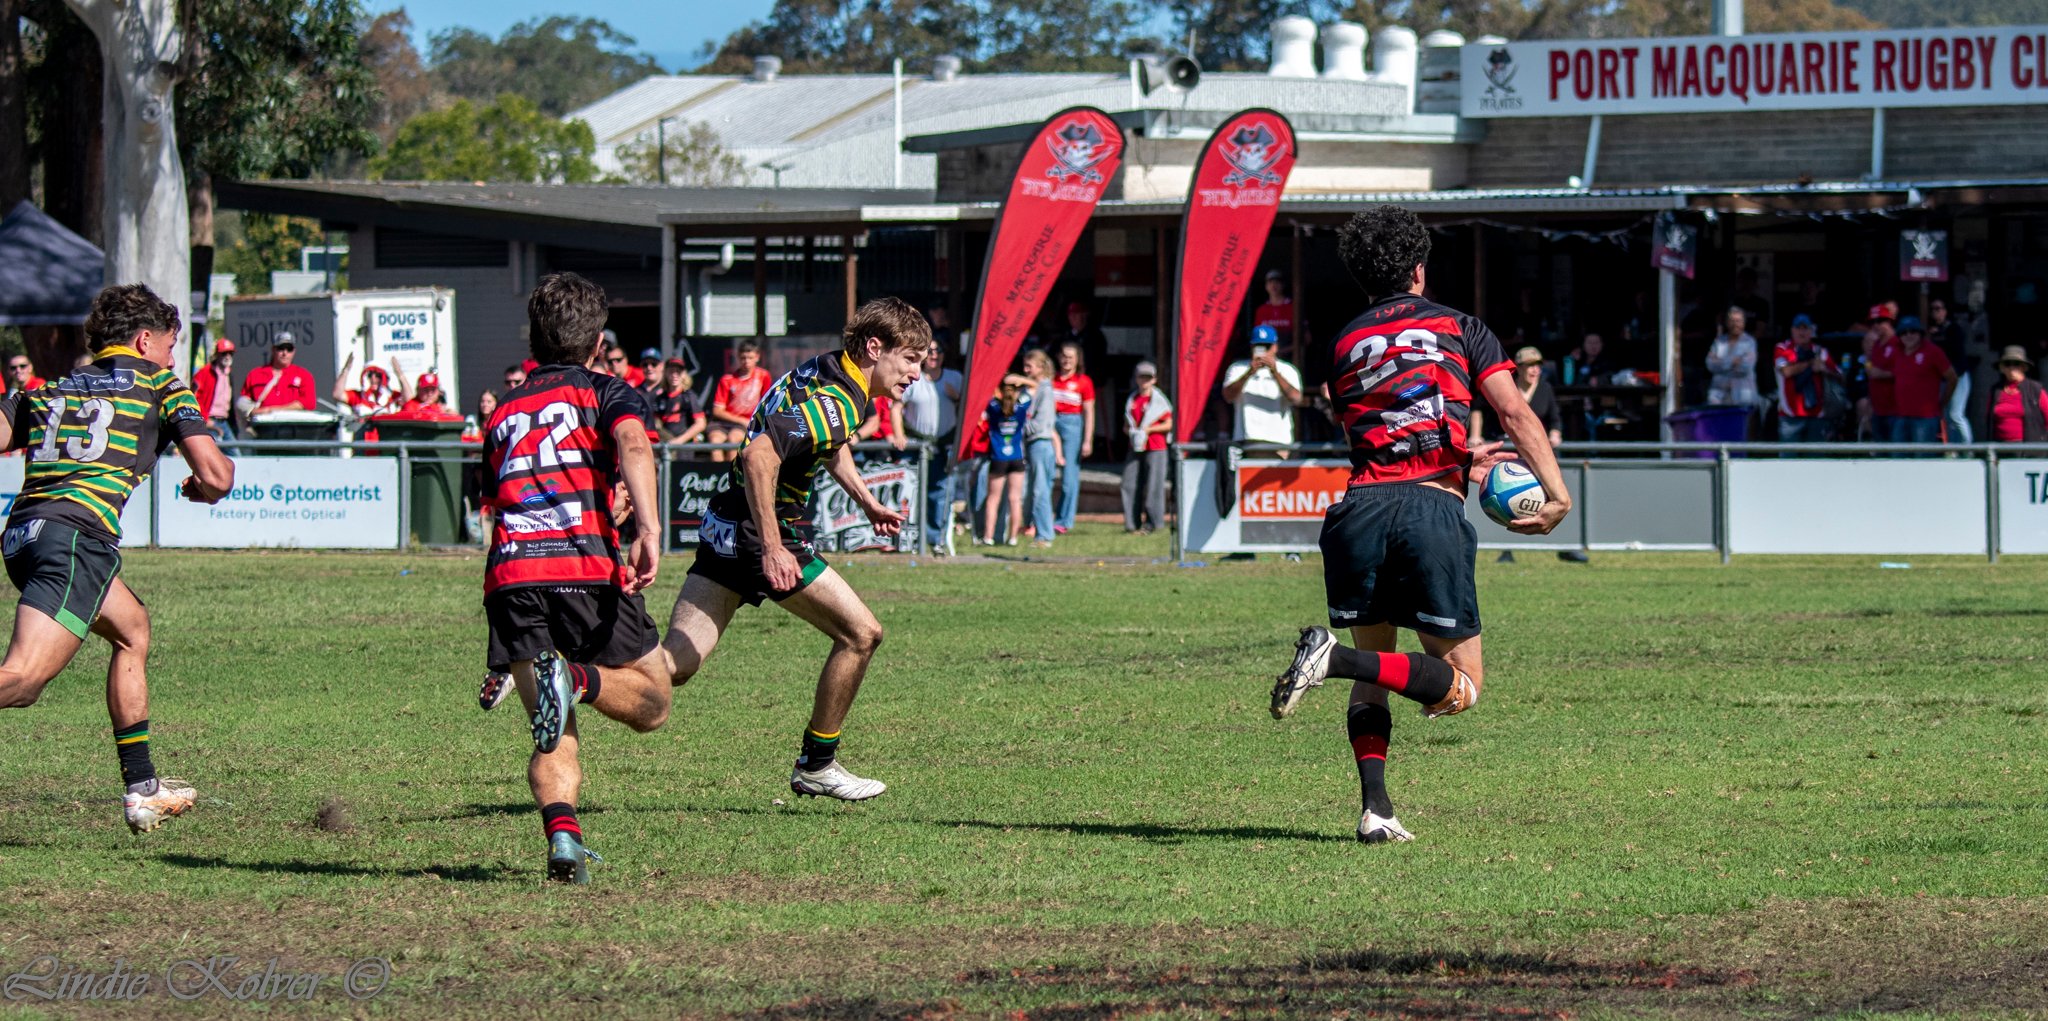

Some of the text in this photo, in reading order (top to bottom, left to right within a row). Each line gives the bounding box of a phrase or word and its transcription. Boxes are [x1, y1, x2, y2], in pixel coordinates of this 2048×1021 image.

[1548, 47, 1640, 101] PORT
[1652, 40, 1861, 105] MACQUARIE
[1873, 34, 1998, 92] RUGBY
[1020, 177, 1098, 202] PIRATES
[1199, 189, 1277, 208] PIRATES
[983, 224, 1057, 347] PORT MACQUARIE
[1201, 231, 1240, 318] MACQUARIE
[378, 312, 428, 326] DOUG'S
[32, 396, 117, 463] 13
[496, 401, 582, 481] 22
[209, 507, 346, 522] Factory Direct Optical
[226, 484, 264, 501] ebb
